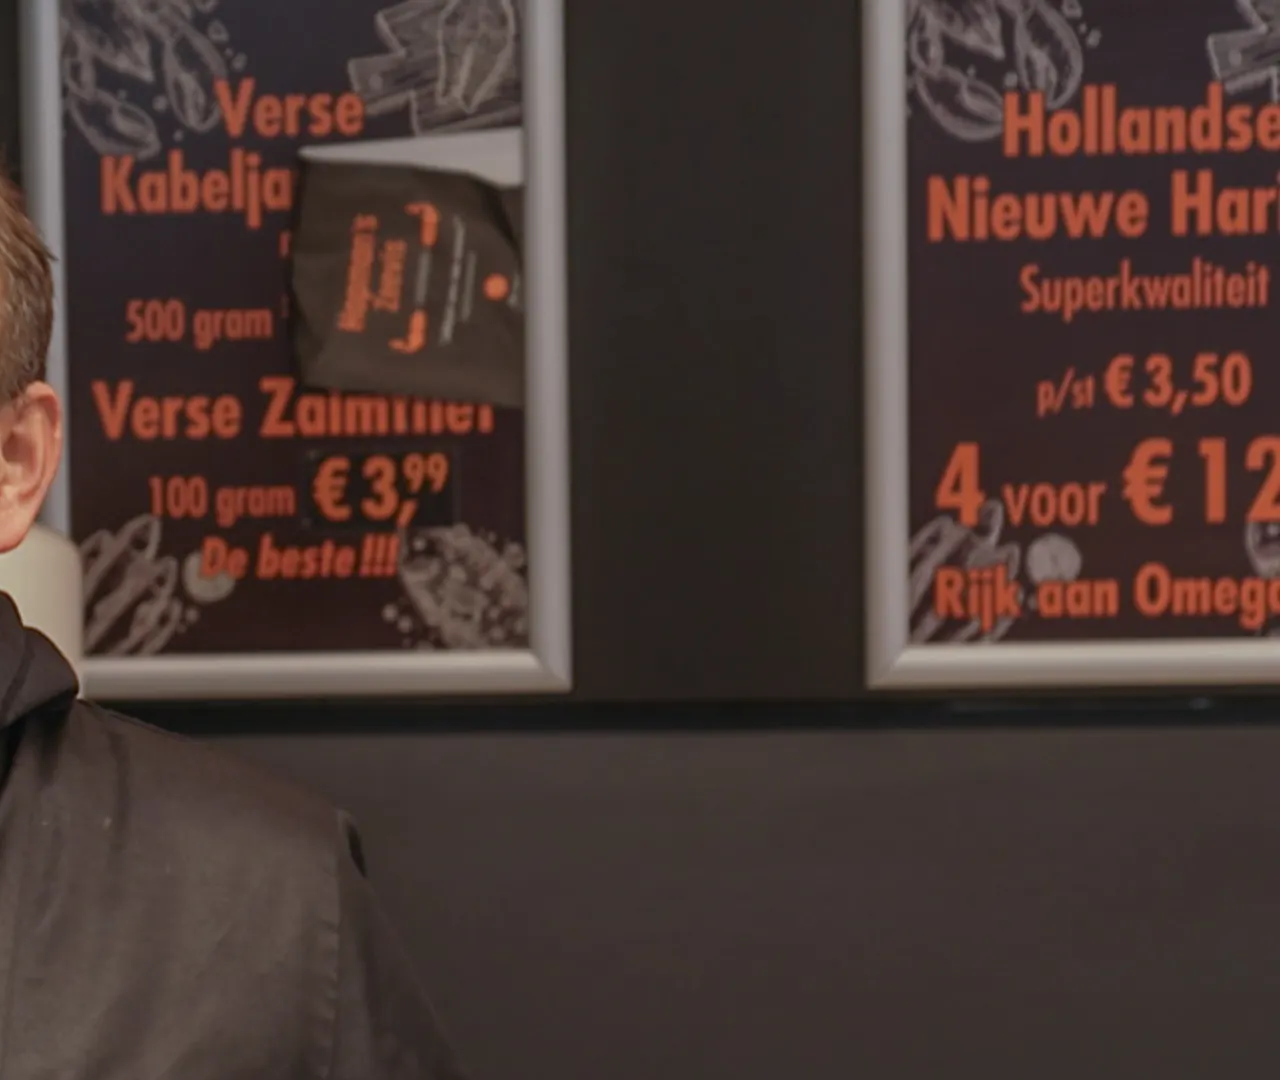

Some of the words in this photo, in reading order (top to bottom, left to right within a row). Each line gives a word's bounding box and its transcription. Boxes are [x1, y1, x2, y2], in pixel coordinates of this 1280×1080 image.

[213, 77, 366, 138] Verse
[1002, 81, 1280, 158] Hollandse
[926, 174, 1150, 243] Nieuwe
[1170, 169, 1280, 236] Har
[1019, 256, 1270, 322] Superkwaliteit
[125, 299, 186, 342] 500
[192, 308, 274, 351] gram
[91, 379, 244, 441] Verse
[1037, 367, 1095, 416] p/st
[1101, 353, 1136, 409] €
[1142, 350, 1254, 416] 3,50
[148, 474, 210, 519] 100
[214, 484, 298, 528] gram
[312, 456, 352, 522] €
[360, 452, 450, 530] 3,99
[933, 441, 988, 529] 4
[1000, 481, 1109, 528] voor
[1120, 435, 1176, 527] €
[1196, 434, 1280, 526] 12
[197, 535, 250, 581] De
[931, 561, 1024, 634] Rijk
[1035, 577, 1122, 619] aan
